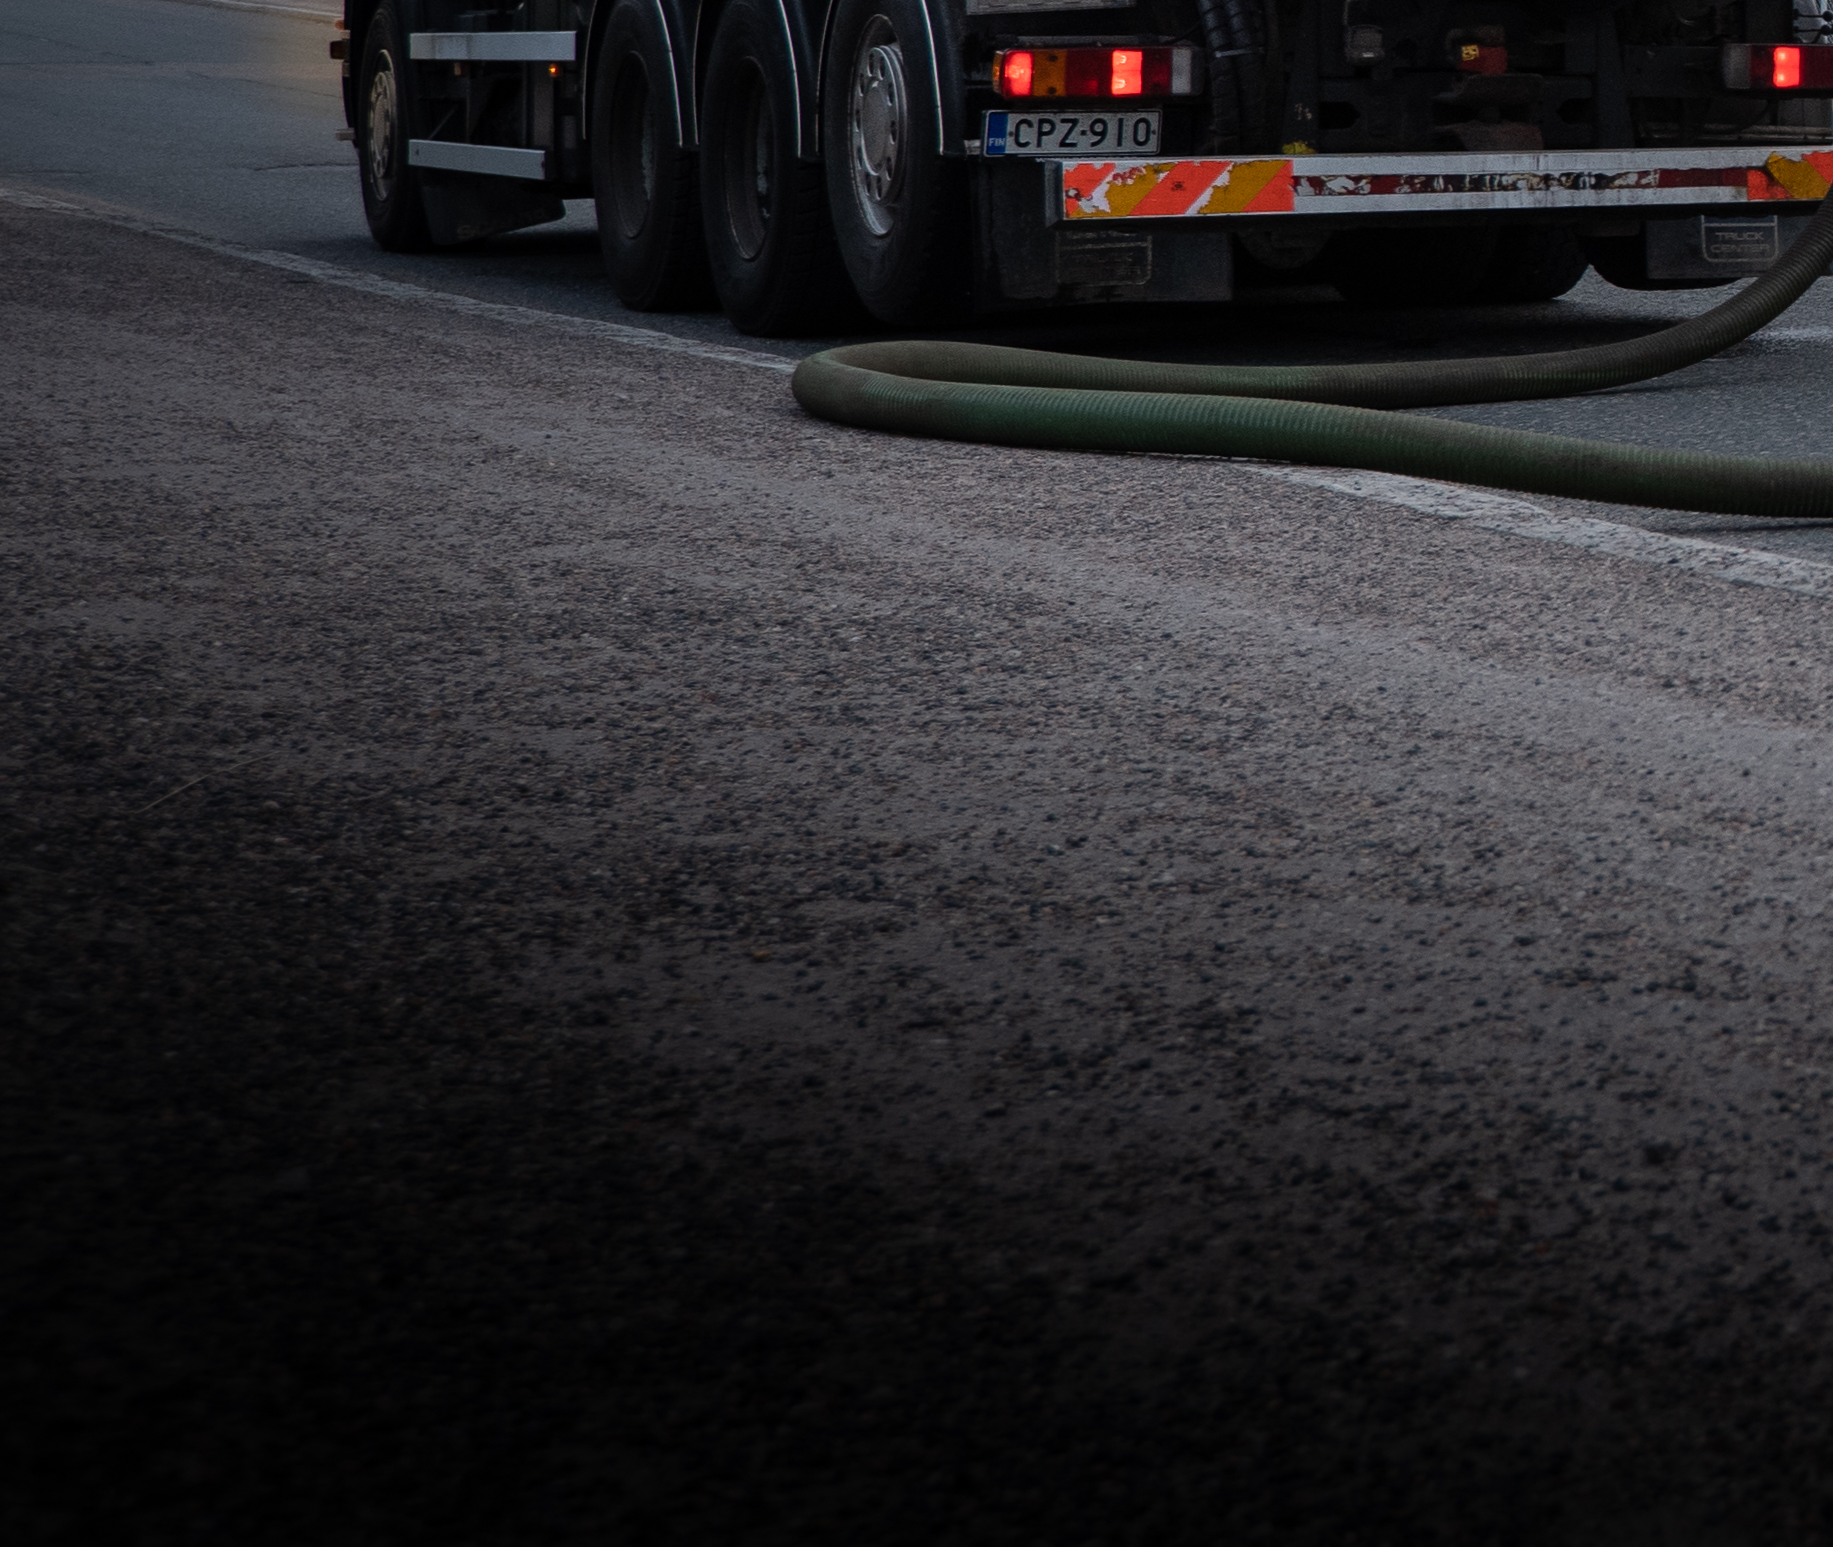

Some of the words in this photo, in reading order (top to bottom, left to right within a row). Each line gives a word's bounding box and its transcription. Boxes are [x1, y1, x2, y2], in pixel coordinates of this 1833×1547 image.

[1014, 117, 1152, 148] CPZ-910
[988, 137, 1006, 147] FIN
[1715, 232, 1765, 241] TRUCK
[1710, 244, 1770, 253] CENTER
